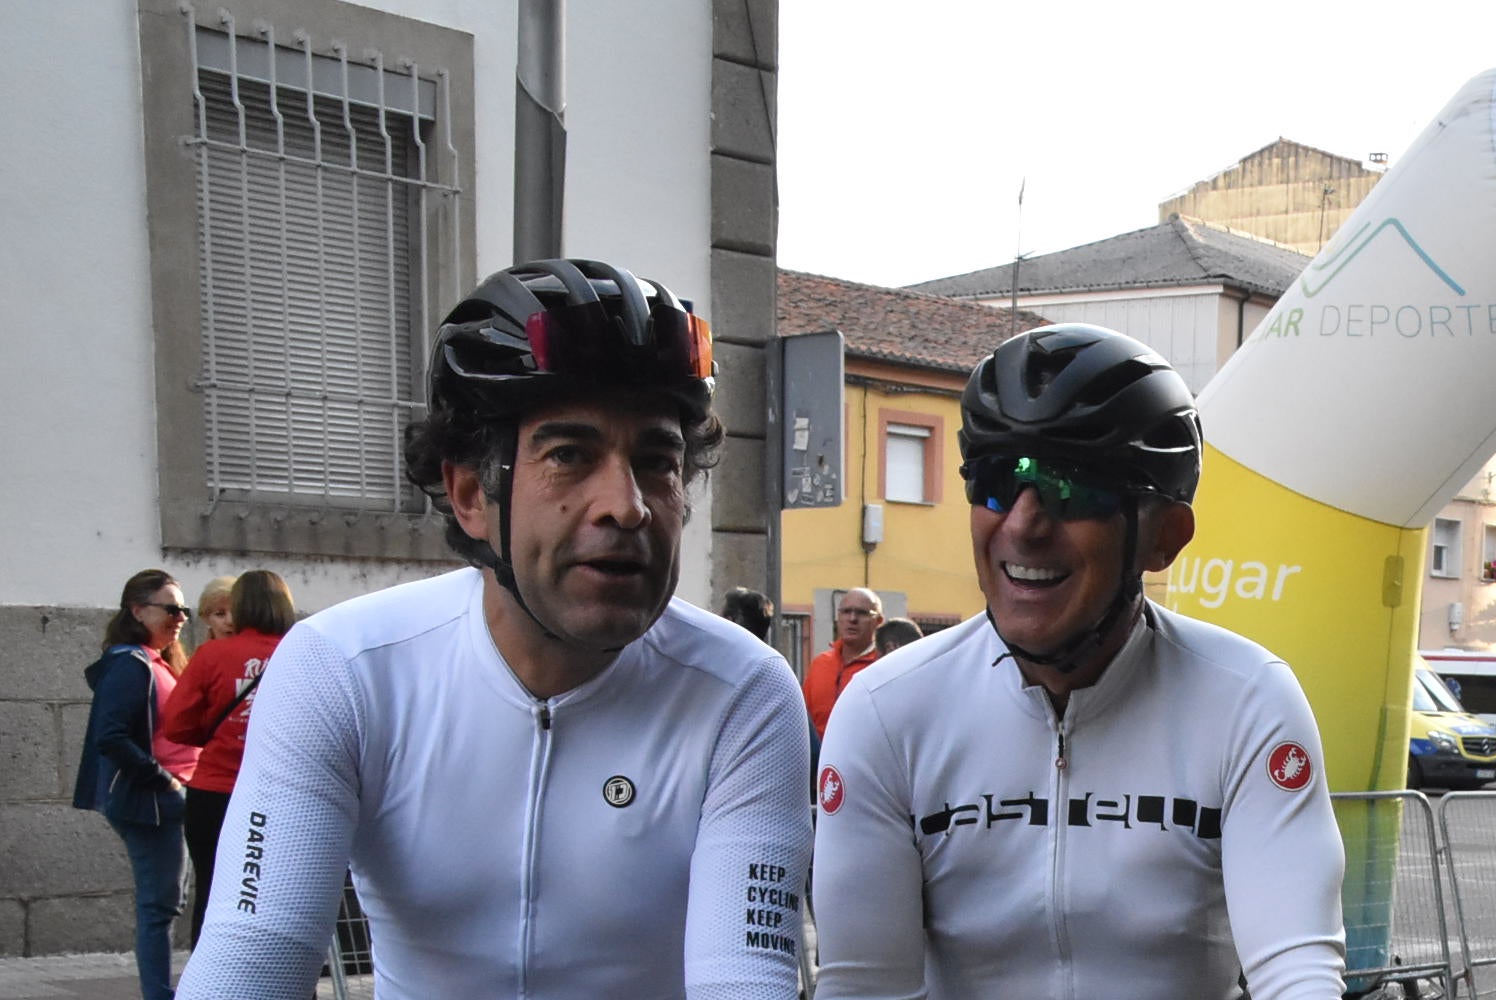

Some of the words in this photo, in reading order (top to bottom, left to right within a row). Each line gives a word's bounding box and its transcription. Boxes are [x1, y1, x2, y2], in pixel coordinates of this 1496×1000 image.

[237, 811, 266, 915] DAREVIE
[748, 863, 785, 882] KEEP
[746, 908, 782, 928] KEEP
